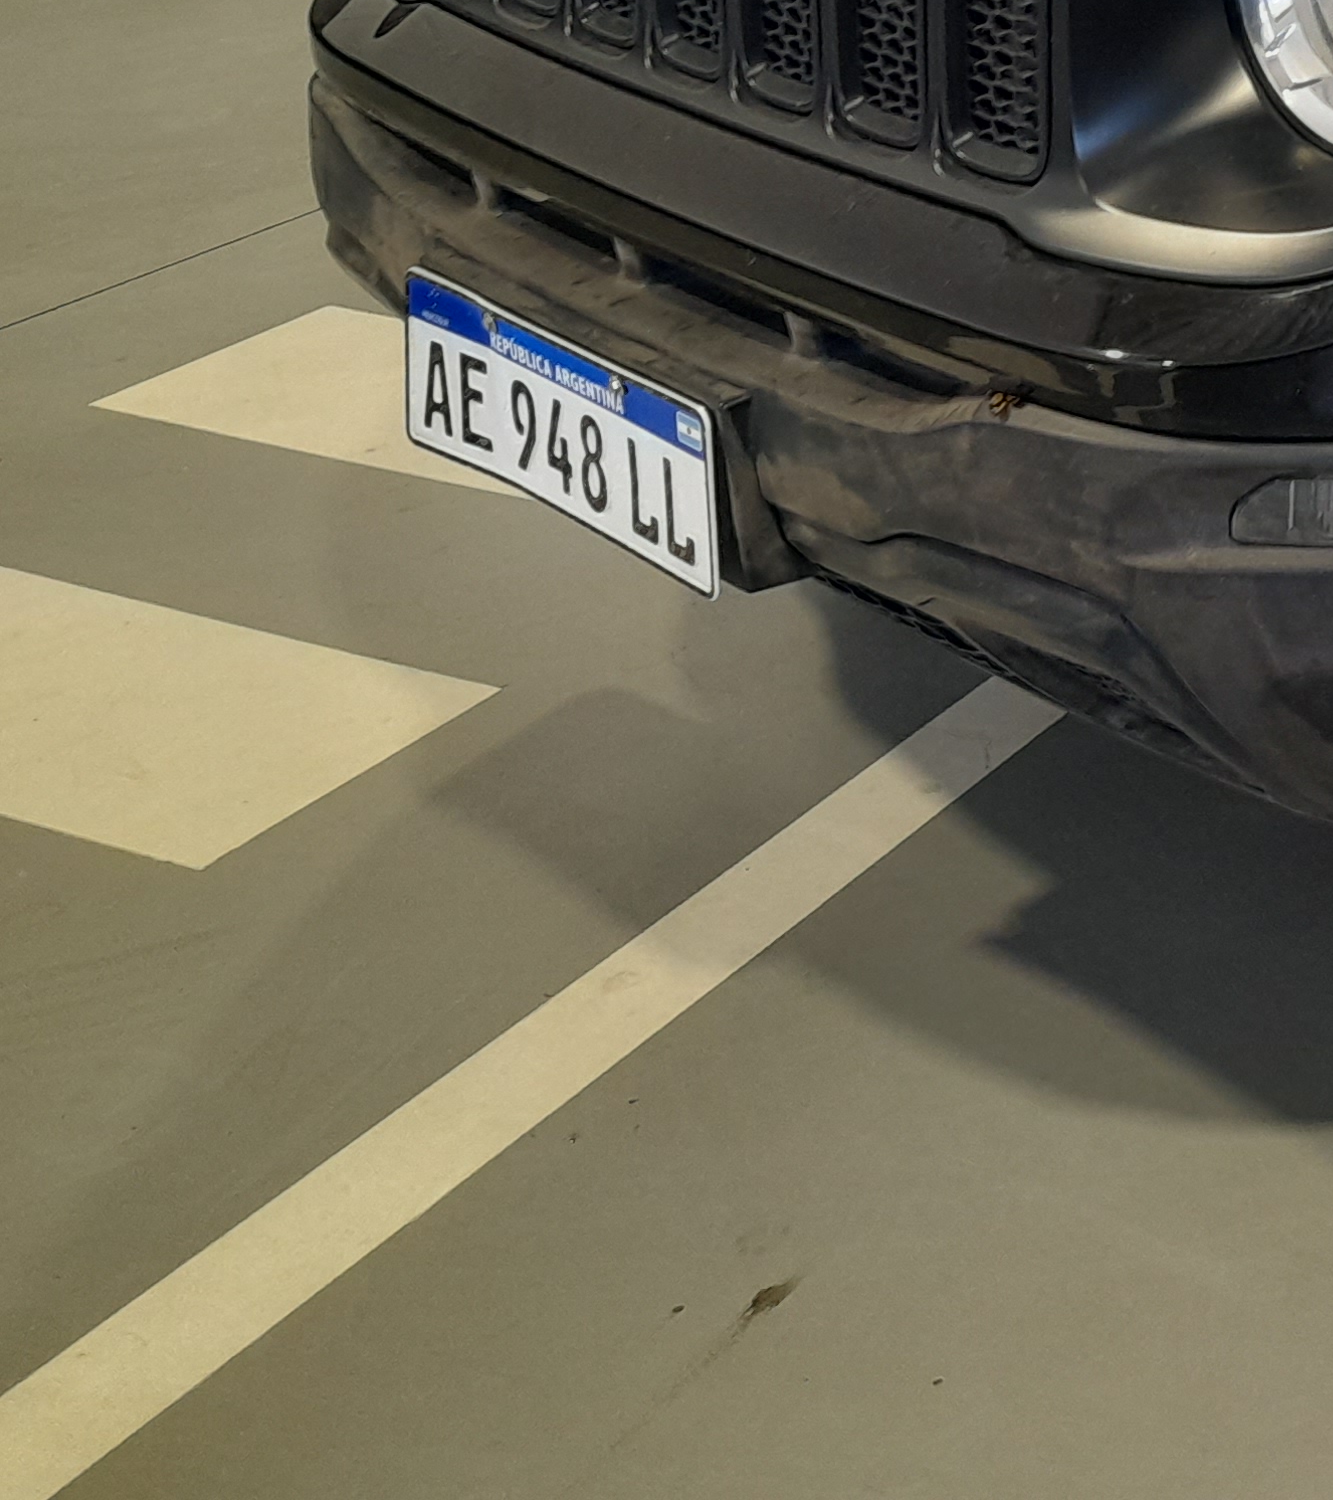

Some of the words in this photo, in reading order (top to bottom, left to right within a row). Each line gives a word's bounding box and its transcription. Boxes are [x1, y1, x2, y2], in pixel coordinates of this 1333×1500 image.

[489, 331, 553, 379] REPÚBLICA
[555, 364, 625, 415] ARGENTINA
[424, 340, 494, 453] AE
[511, 379, 608, 514] 948
[627, 436, 695, 567] LL
